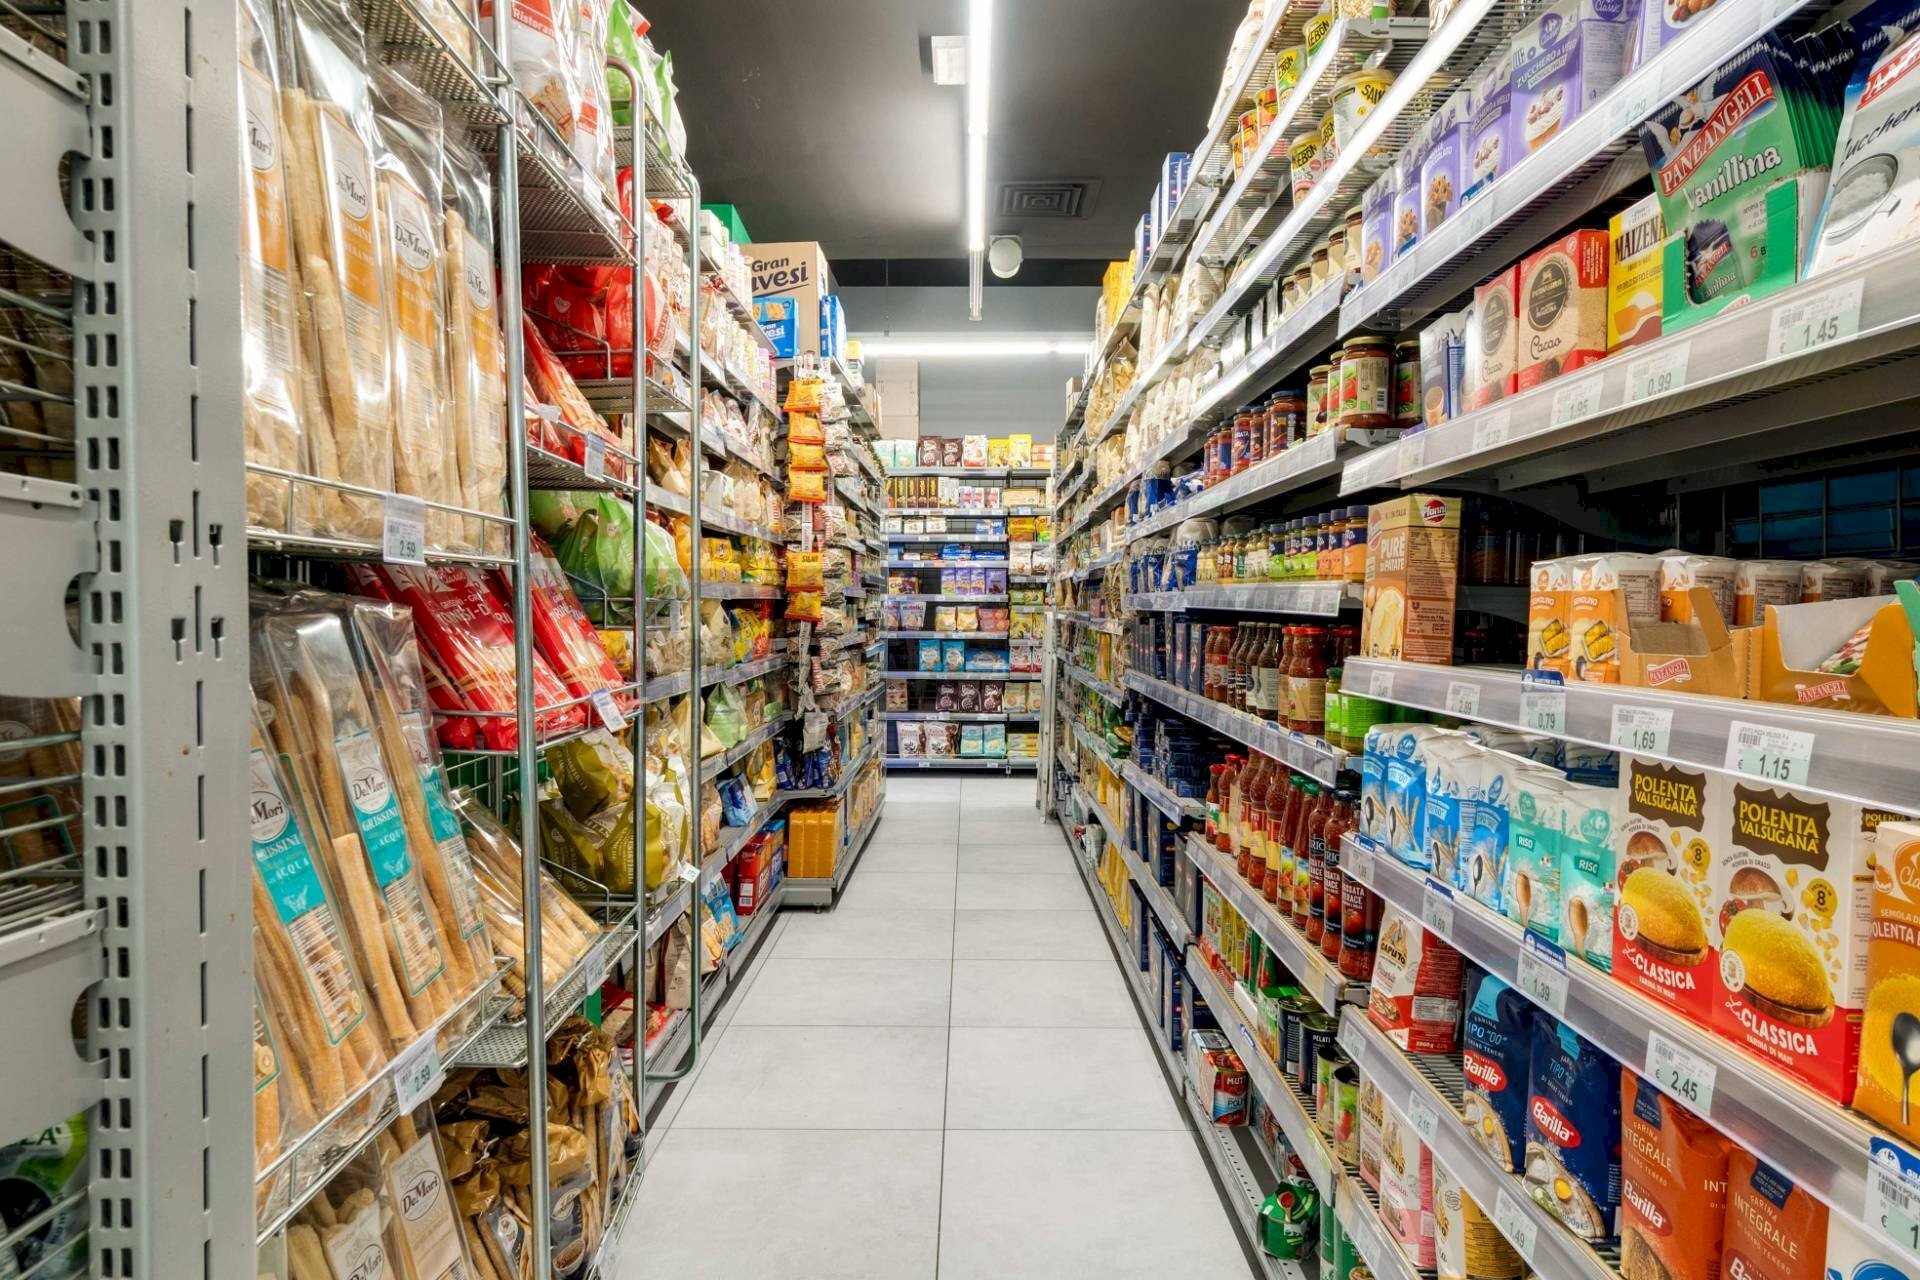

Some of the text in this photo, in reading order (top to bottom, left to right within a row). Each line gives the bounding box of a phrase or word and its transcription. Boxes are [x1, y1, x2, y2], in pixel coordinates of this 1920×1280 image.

[1683, 146, 1782, 212] Vanillina
[394, 224, 431, 261] DeMori
[1614, 213, 1668, 265] MAIZENA
[752, 258, 790, 273] Gran
[1530, 335, 1562, 360] Cacao
[1424, 503, 1447, 517] Pfanni
[1798, 680, 1848, 703] PANEANGELI
[352, 775, 386, 800] DeMori
[1634, 774, 1697, 804] POLENTA
[1635, 790, 1697, 818] VALSUGANA
[1739, 801, 1819, 838] POLENTA
[1518, 836, 1533, 849] RISO
[1739, 820, 1820, 855] VALSUGANA
[1578, 859, 1599, 874] RISO
[1817, 890, 1826, 906] 8
[1880, 909, 1911, 922] SEMOLA
[1872, 921, 1914, 945] OLENTA
[1380, 942, 1406, 965] CAPUTO
[1634, 953, 1696, 990] CLASSICA
[1312, 1034, 1331, 1043] PELATI
[1740, 1012, 1818, 1056] CLASSICA
[1463, 1054, 1499, 1086] Barilla
[1533, 1101, 1572, 1142] Barilla
[1633, 1121, 1659, 1143] FARINA
[402, 1174, 440, 1214] DeMori
[1623, 1180, 1663, 1229] Barilla
[1750, 1195, 1777, 1222] FARINA
[1880, 1215, 1888, 1228] €
[1734, 1191, 1798, 1261] INTEGRALE
